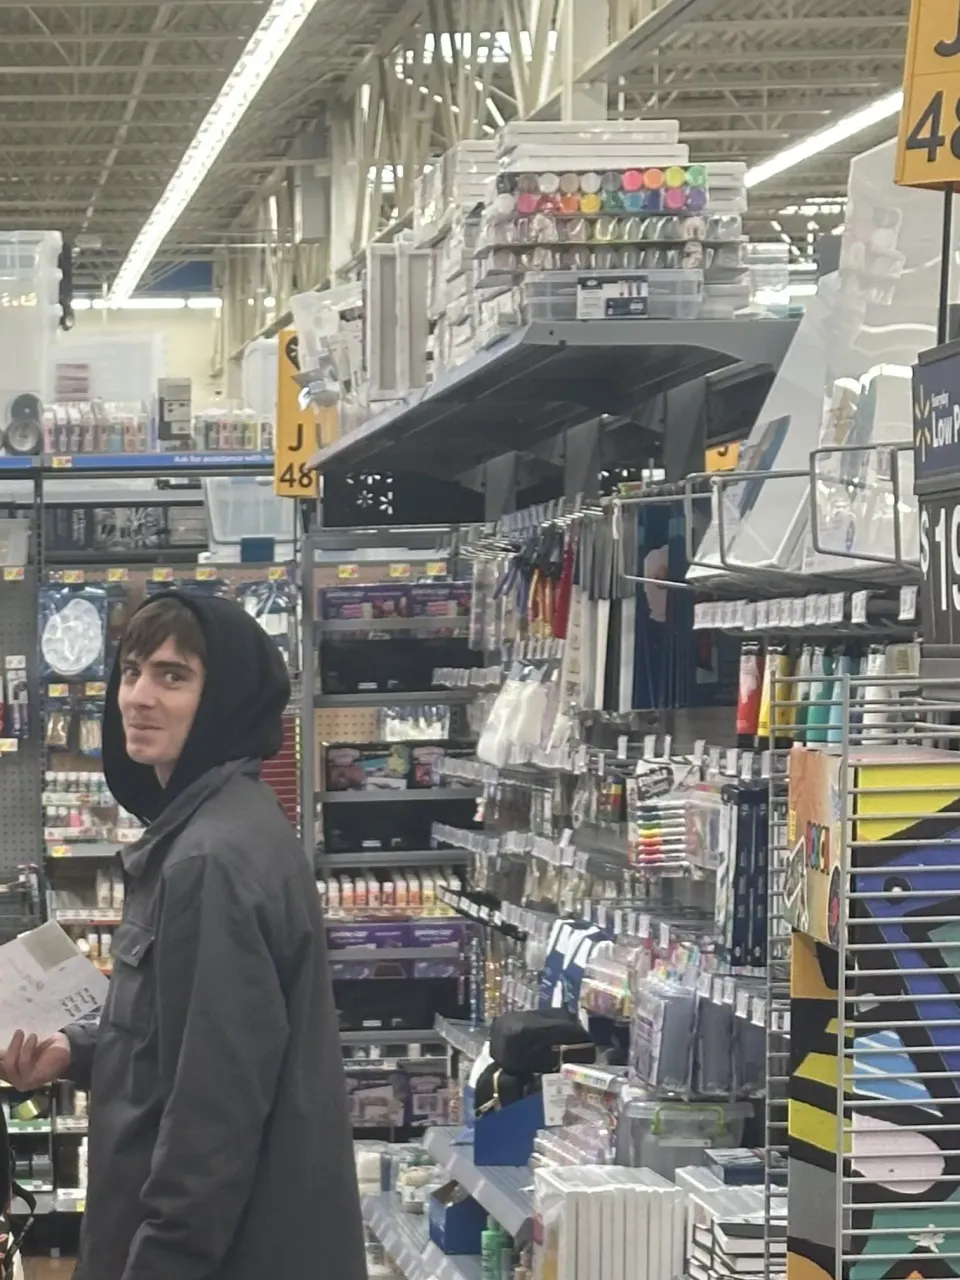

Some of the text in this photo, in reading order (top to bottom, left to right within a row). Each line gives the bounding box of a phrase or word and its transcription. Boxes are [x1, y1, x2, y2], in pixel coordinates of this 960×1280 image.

[906, 90, 960, 162] 4
[288, 424, 303, 451] J
[932, 411, 952, 447] Low
[279, 462, 313, 488] 48
